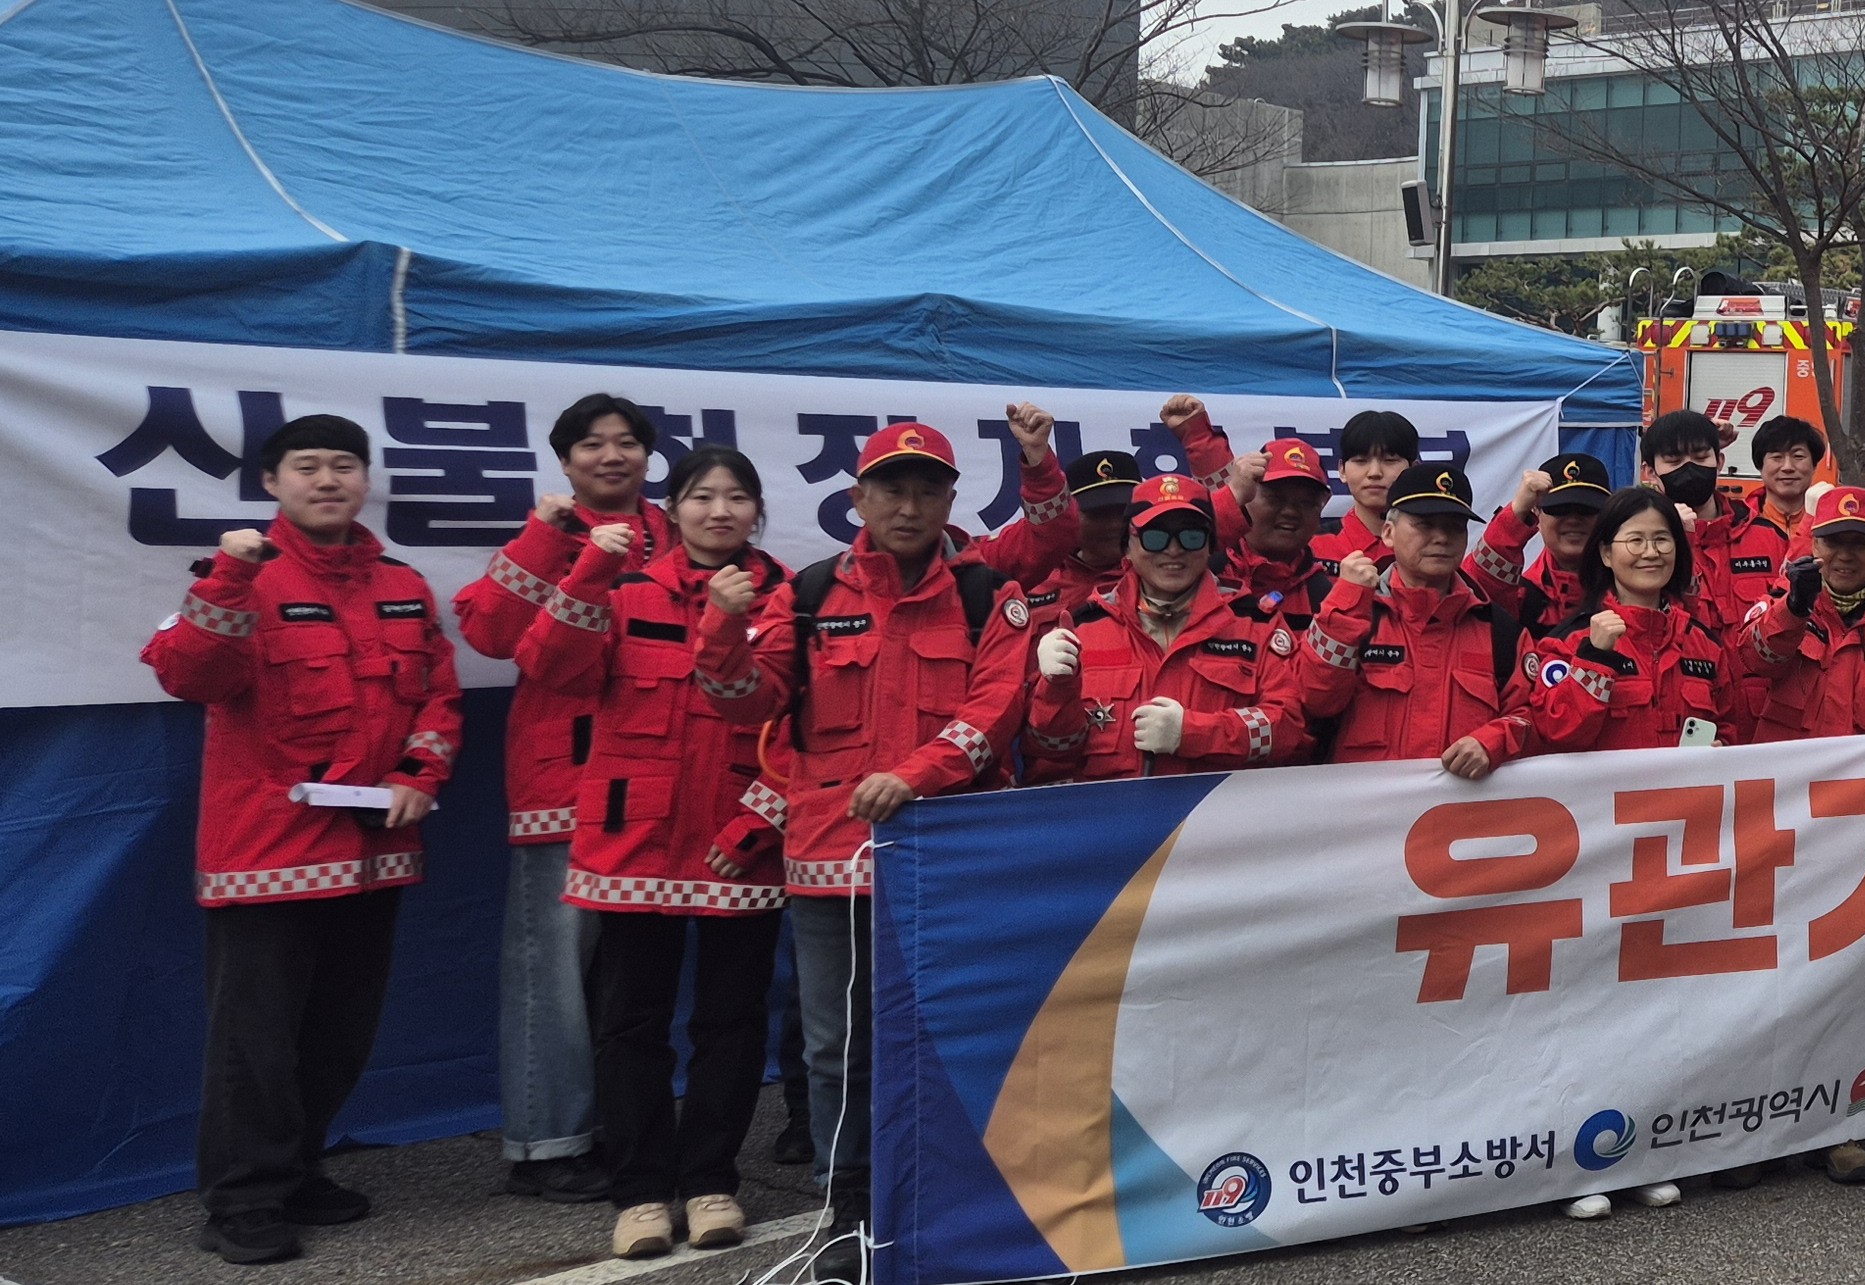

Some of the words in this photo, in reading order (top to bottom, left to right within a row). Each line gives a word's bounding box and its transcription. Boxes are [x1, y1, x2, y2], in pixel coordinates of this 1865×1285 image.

[1649, 1079, 1843, 1149] 인천광역시
[1200, 1175, 1247, 1209] 119
[1287, 1130, 1556, 1206] 인천중부소방서
